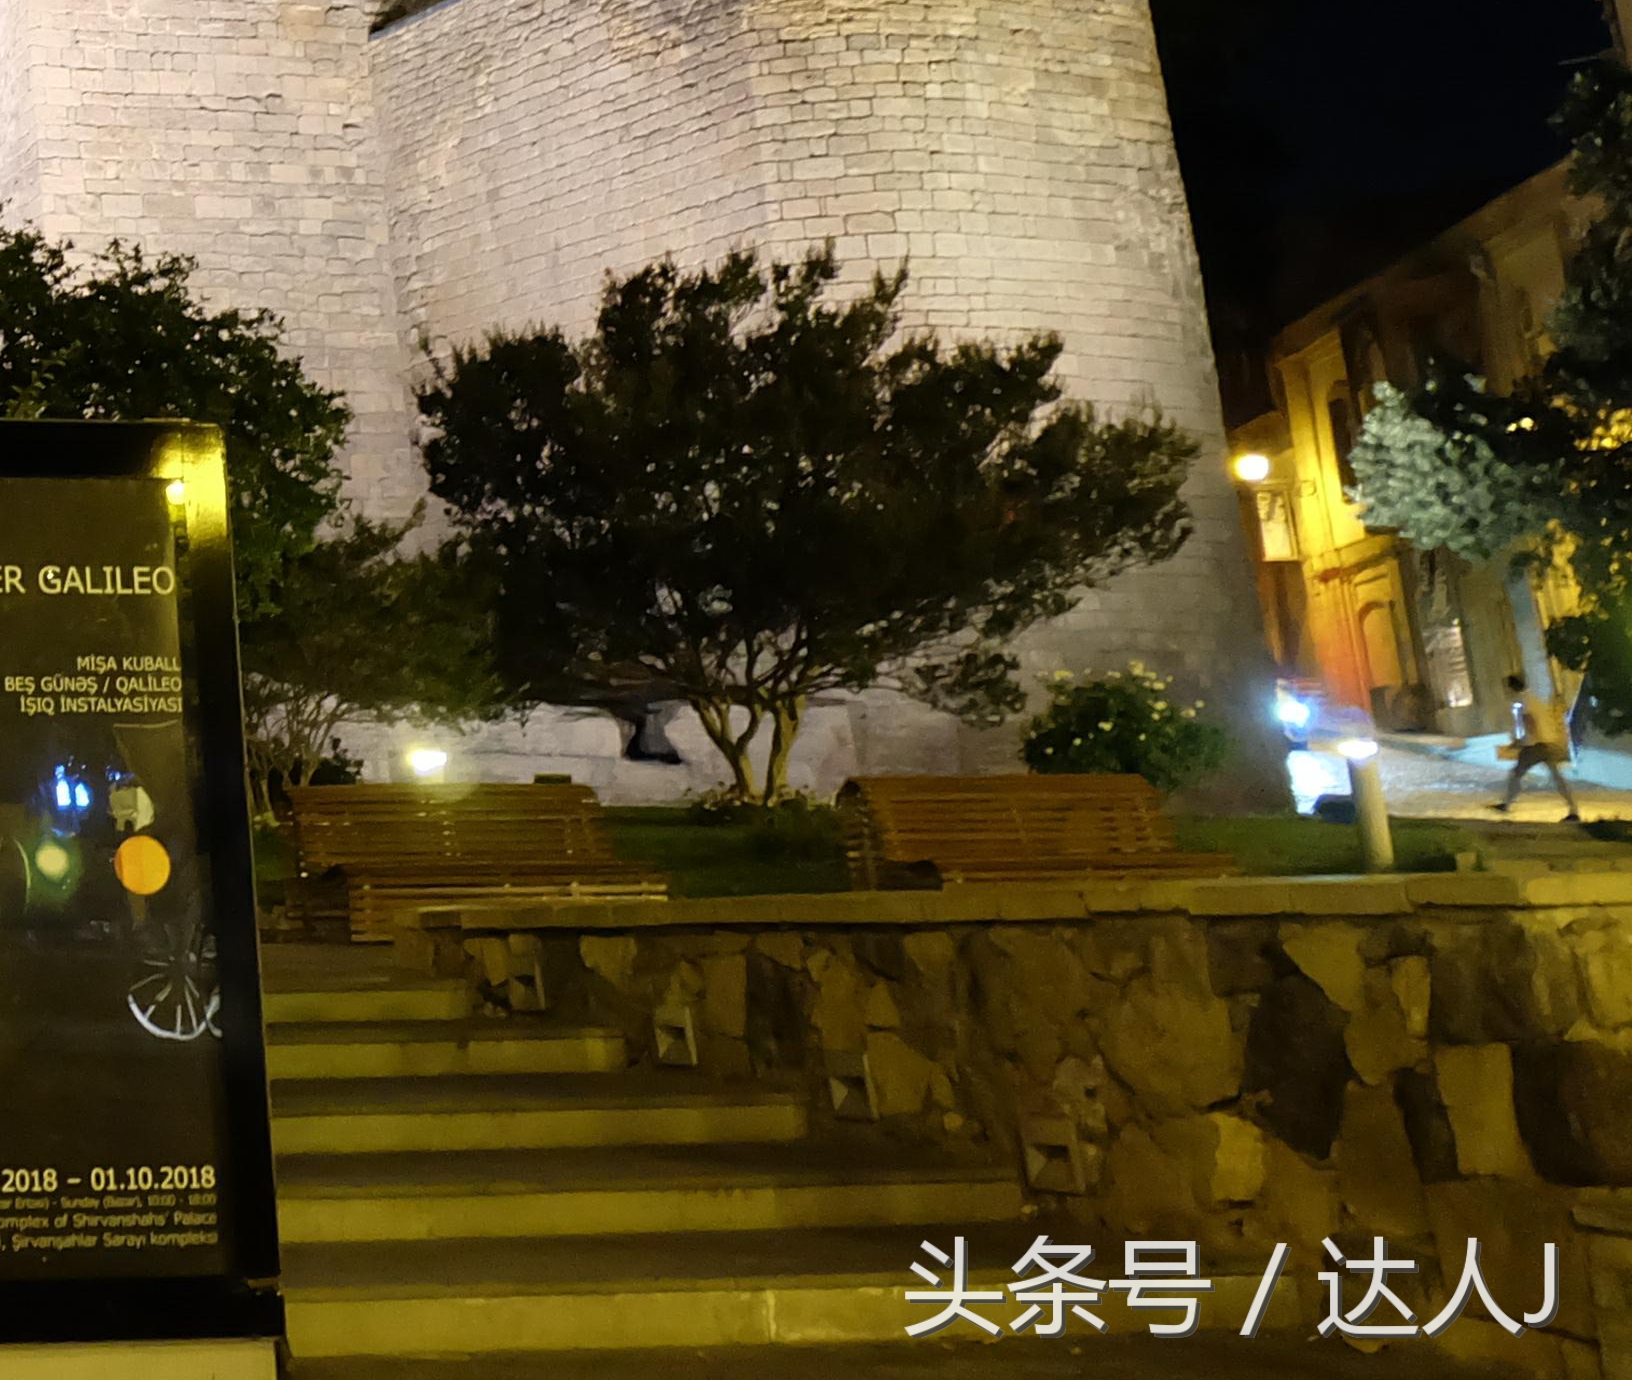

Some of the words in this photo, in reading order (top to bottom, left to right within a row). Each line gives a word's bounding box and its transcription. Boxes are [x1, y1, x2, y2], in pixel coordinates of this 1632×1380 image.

[38, 565, 176, 595] GALILEO
[122, 656, 182, 672] KUBALL
[102, 676, 111, 694] /
[90, 1164, 216, 1192] 01.10.2018
[53, 1213, 69, 1229] of
[173, 1209, 217, 1226] Palace
